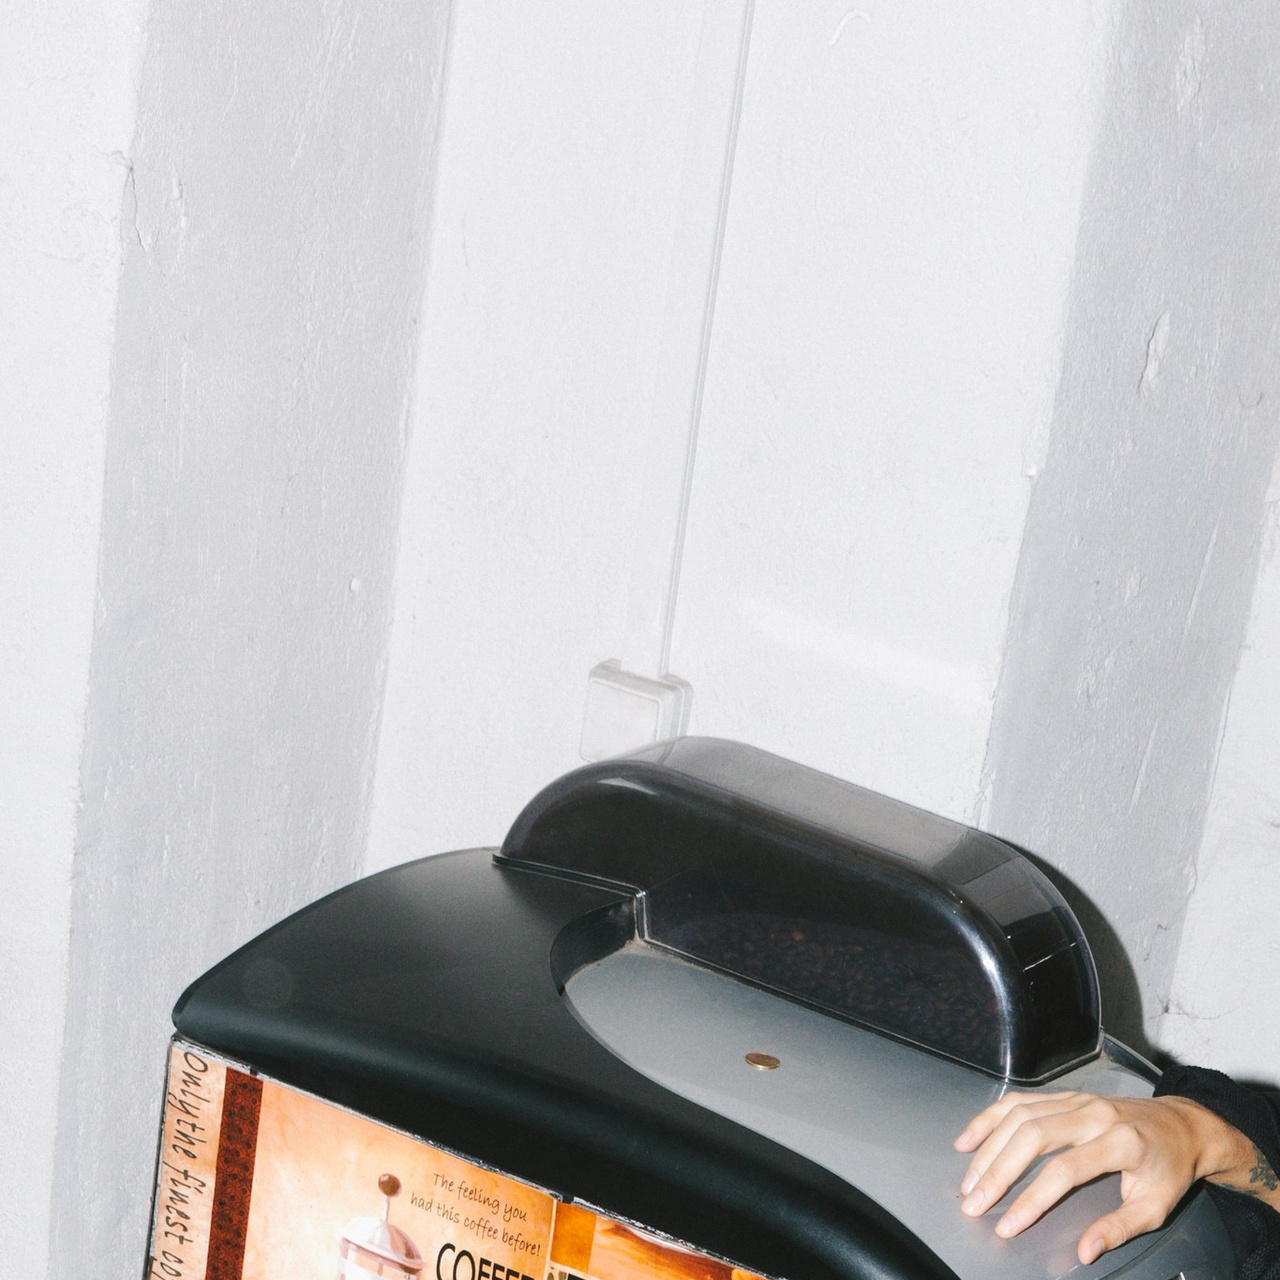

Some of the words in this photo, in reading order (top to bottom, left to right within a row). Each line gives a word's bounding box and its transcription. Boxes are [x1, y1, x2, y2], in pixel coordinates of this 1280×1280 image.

[162, 1160, 207, 1244] finest
[410, 1191, 434, 1213] had
[437, 1201, 461, 1225] this
[463, 1212, 499, 1242] coffee
[501, 1223, 542, 1257] before!
[433, 1172, 455, 1193] The
[457, 1181, 501, 1214] feeling
[502, 1202, 528, 1223] you
